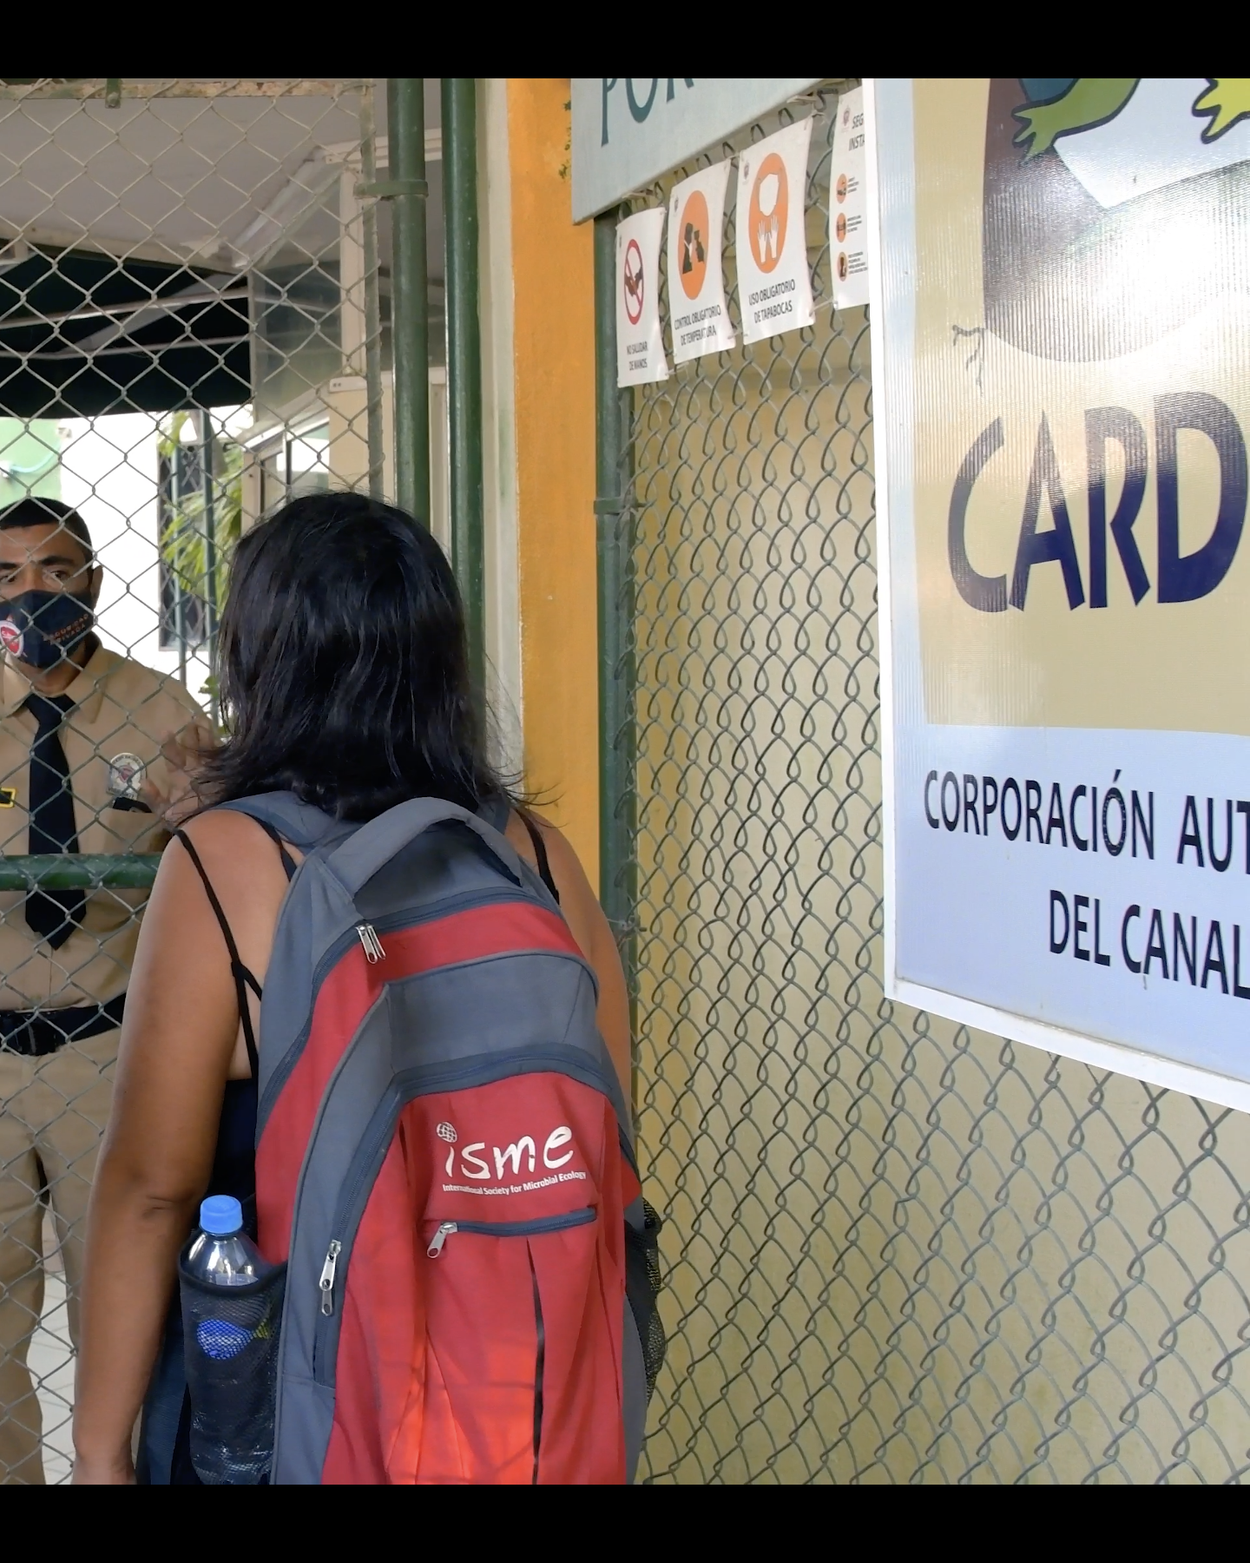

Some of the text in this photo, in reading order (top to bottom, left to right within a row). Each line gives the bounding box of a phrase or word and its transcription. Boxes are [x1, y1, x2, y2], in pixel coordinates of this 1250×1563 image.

[749, 279, 796, 306] USO OBLIGATORIO
[674, 304, 722, 330] CONTROL OBLIGATORIO
[754, 300, 793, 323] DE TAPABOCAS
[681, 334, 687, 346] DE
[924, 769, 1154, 860] CORPORACIÓN
[1049, 889, 1250, 1000] DEL CANAL
[442, 1170, 587, 1196] International Society for Microbial Ecology
